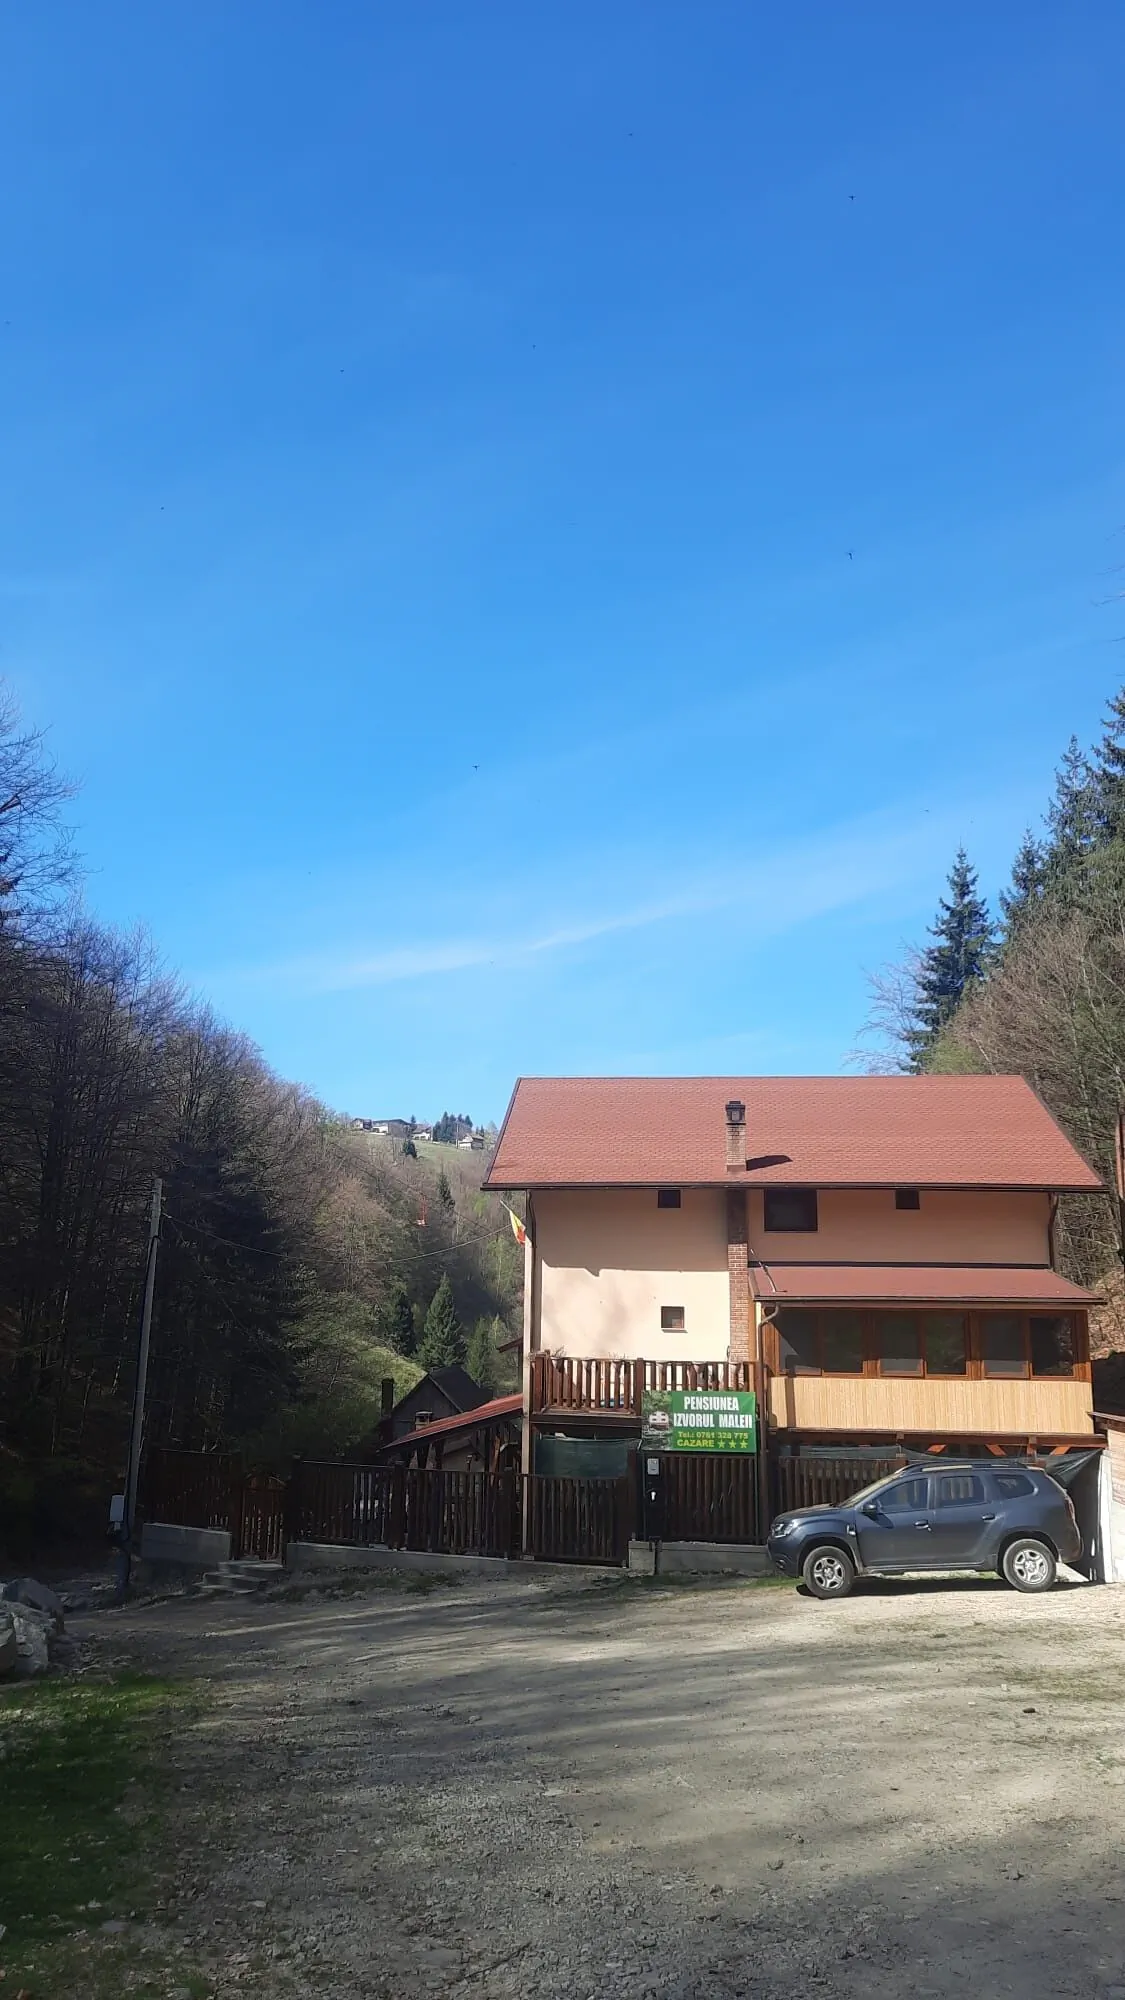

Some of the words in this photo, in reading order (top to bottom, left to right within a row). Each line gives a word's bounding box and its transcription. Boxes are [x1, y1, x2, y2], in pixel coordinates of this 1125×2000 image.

[684, 1396, 739, 1411] PENSIUNEA
[673, 1413, 714, 1428] IZVORUL
[719, 1414, 752, 1429] MALEII
[677, 1439, 714, 1448] CAZARE
